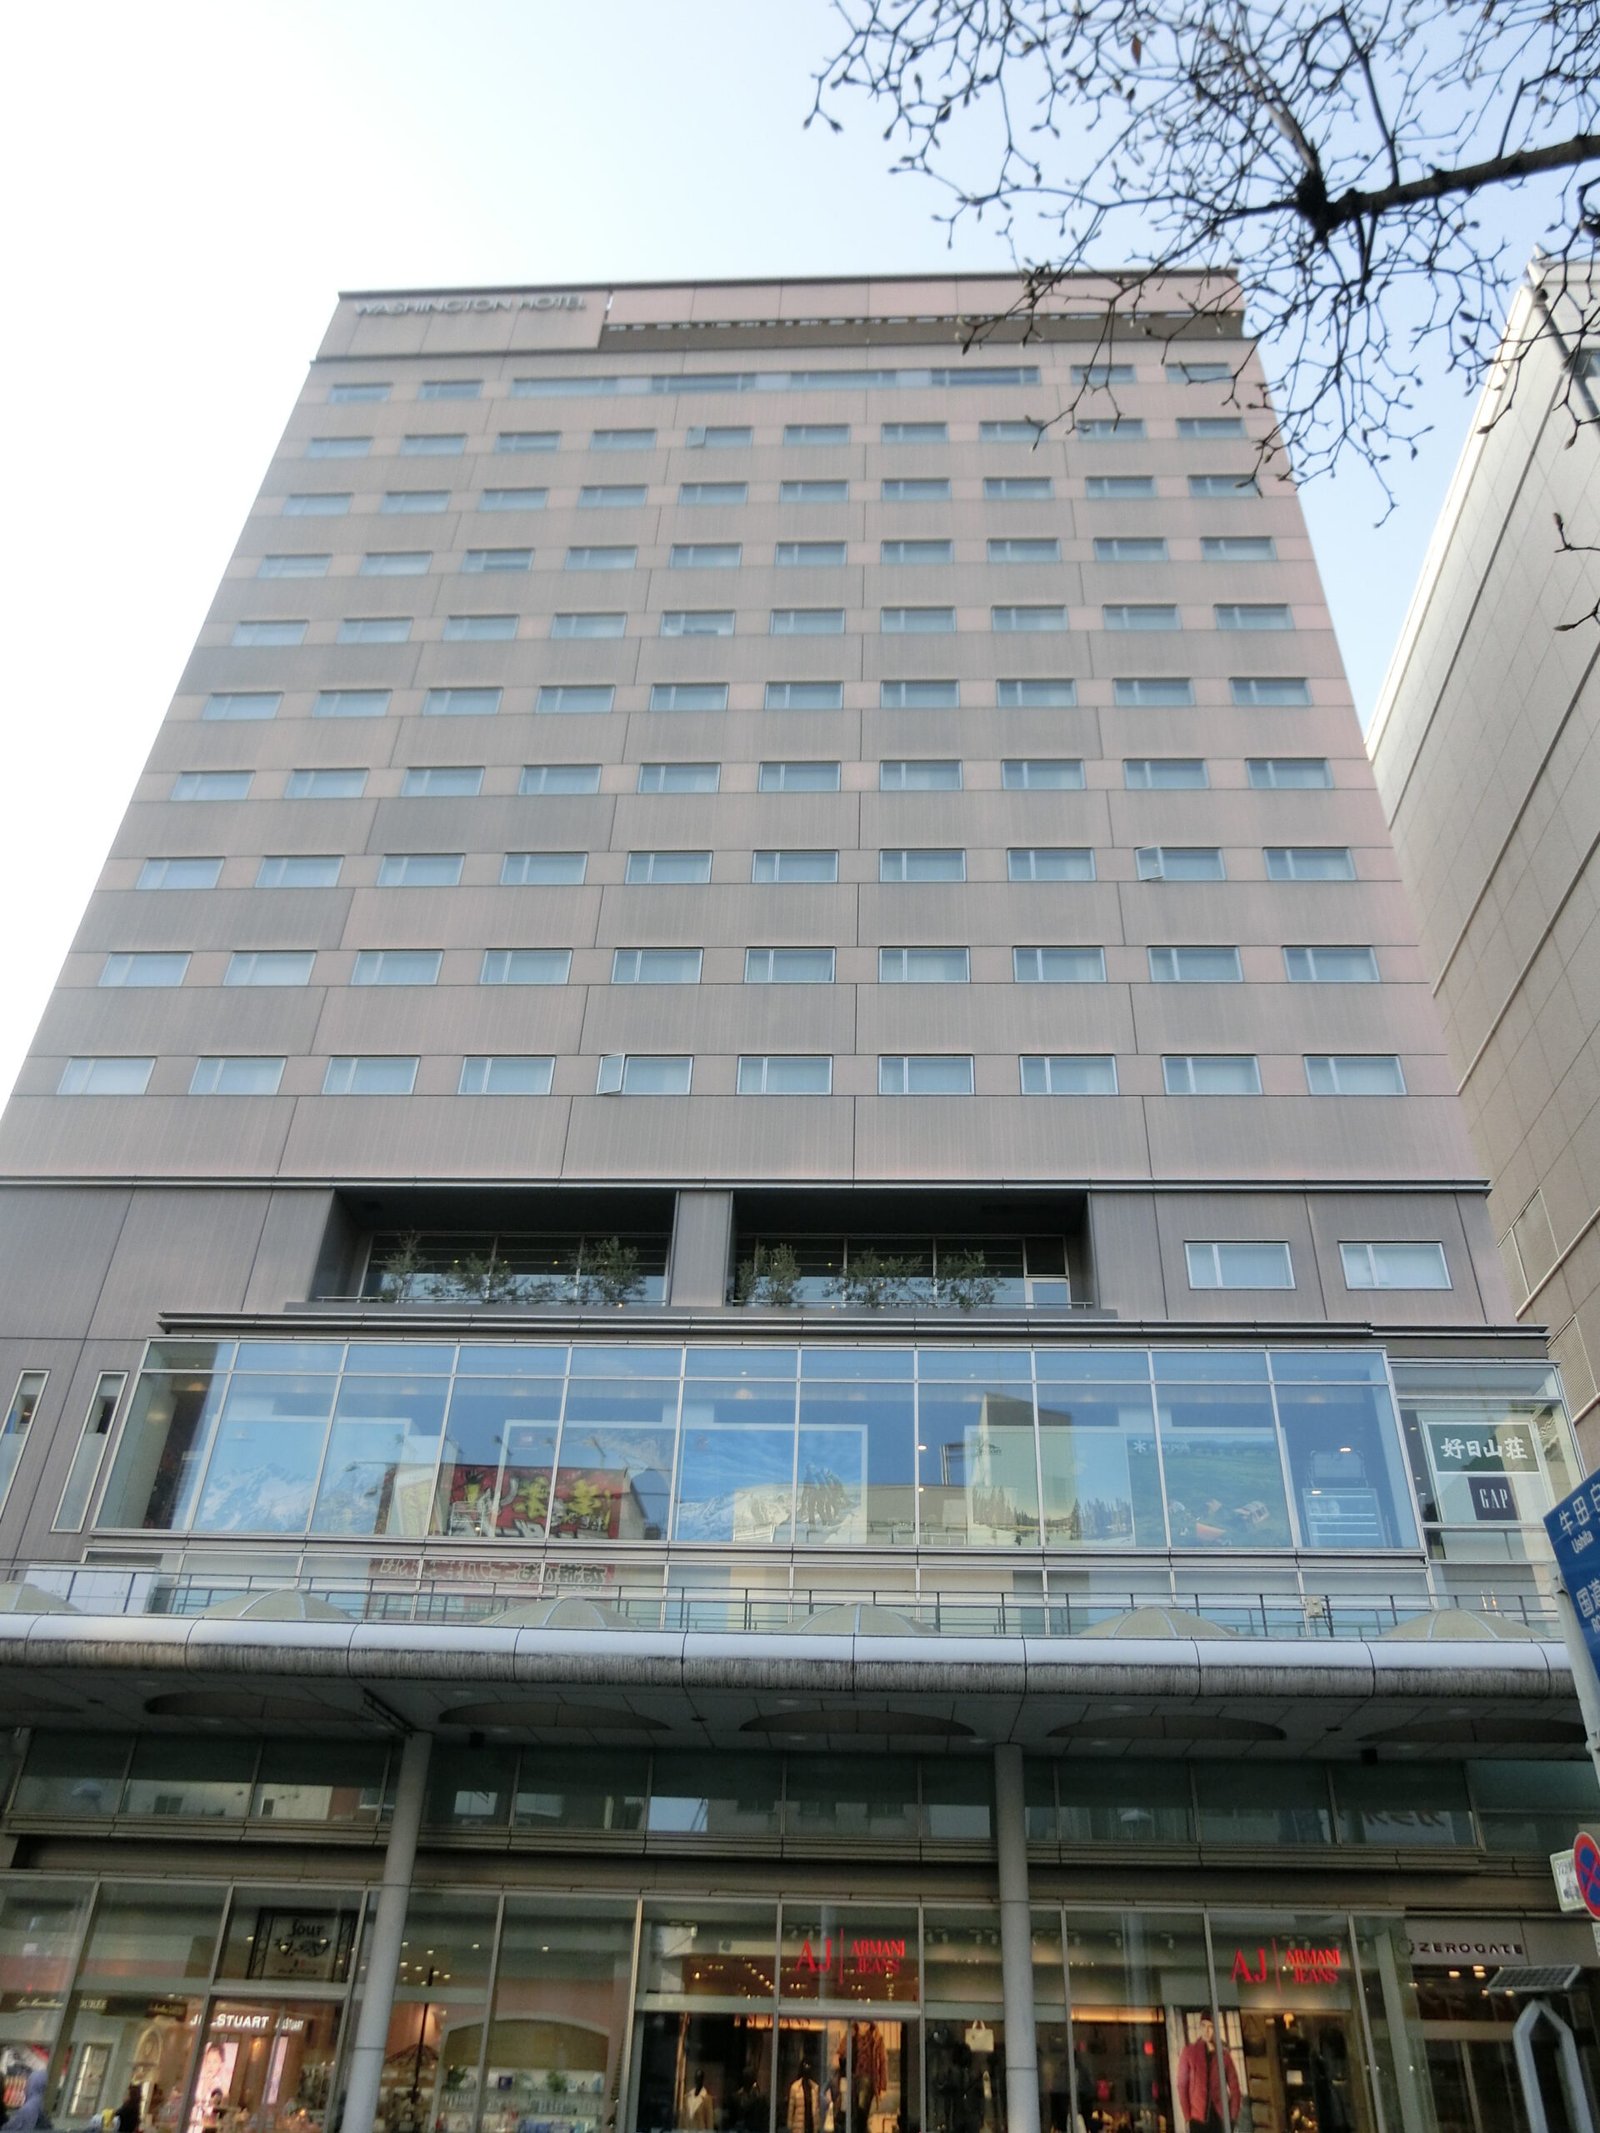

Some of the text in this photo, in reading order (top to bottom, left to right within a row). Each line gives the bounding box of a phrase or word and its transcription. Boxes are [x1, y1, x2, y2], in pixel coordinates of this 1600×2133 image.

[355, 294, 586, 317] WASHINGTON HOTEL
[1441, 1436, 1528, 1459] 好日山荘
[1479, 1488, 1508, 1509] GAP
[795, 1937, 832, 1972] AJ
[850, 1938, 905, 1957] ARMANI
[1285, 1947, 1341, 1967] ARMANI
[857, 1957, 900, 1973] JEANS
[1229, 1947, 1267, 1983] AJ
[1293, 1967, 1338, 1984] JEANS
